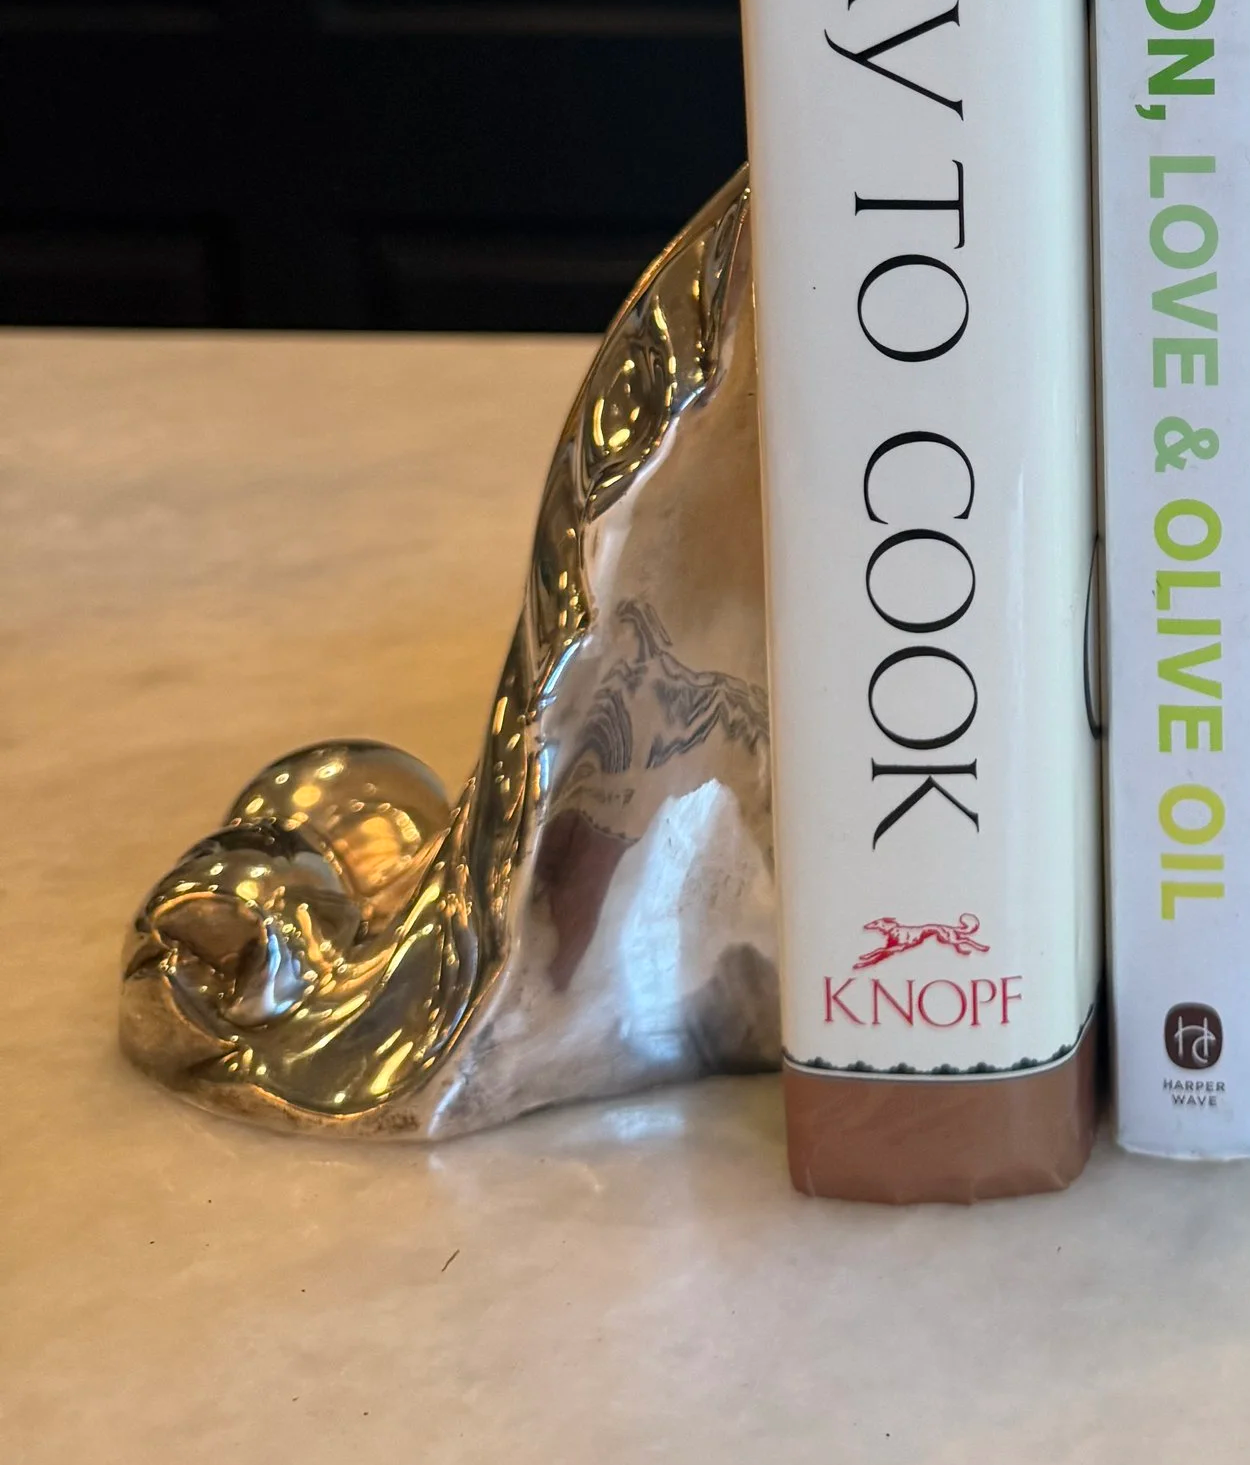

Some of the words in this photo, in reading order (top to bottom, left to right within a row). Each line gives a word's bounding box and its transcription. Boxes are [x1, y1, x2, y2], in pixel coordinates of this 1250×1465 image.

[854, 160, 969, 362] TO
[1149, 156, 1218, 388] LOVE
[1154, 416, 1219, 472] &
[863, 431, 979, 850] COOK
[1152, 499, 1223, 753] OLIVE
[1158, 784, 1225, 921] OIL
[823, 975, 1022, 1028] KNOPF
[1162, 1079, 1225, 1092] HARPER
[1171, 1094, 1217, 1107] WAVE
